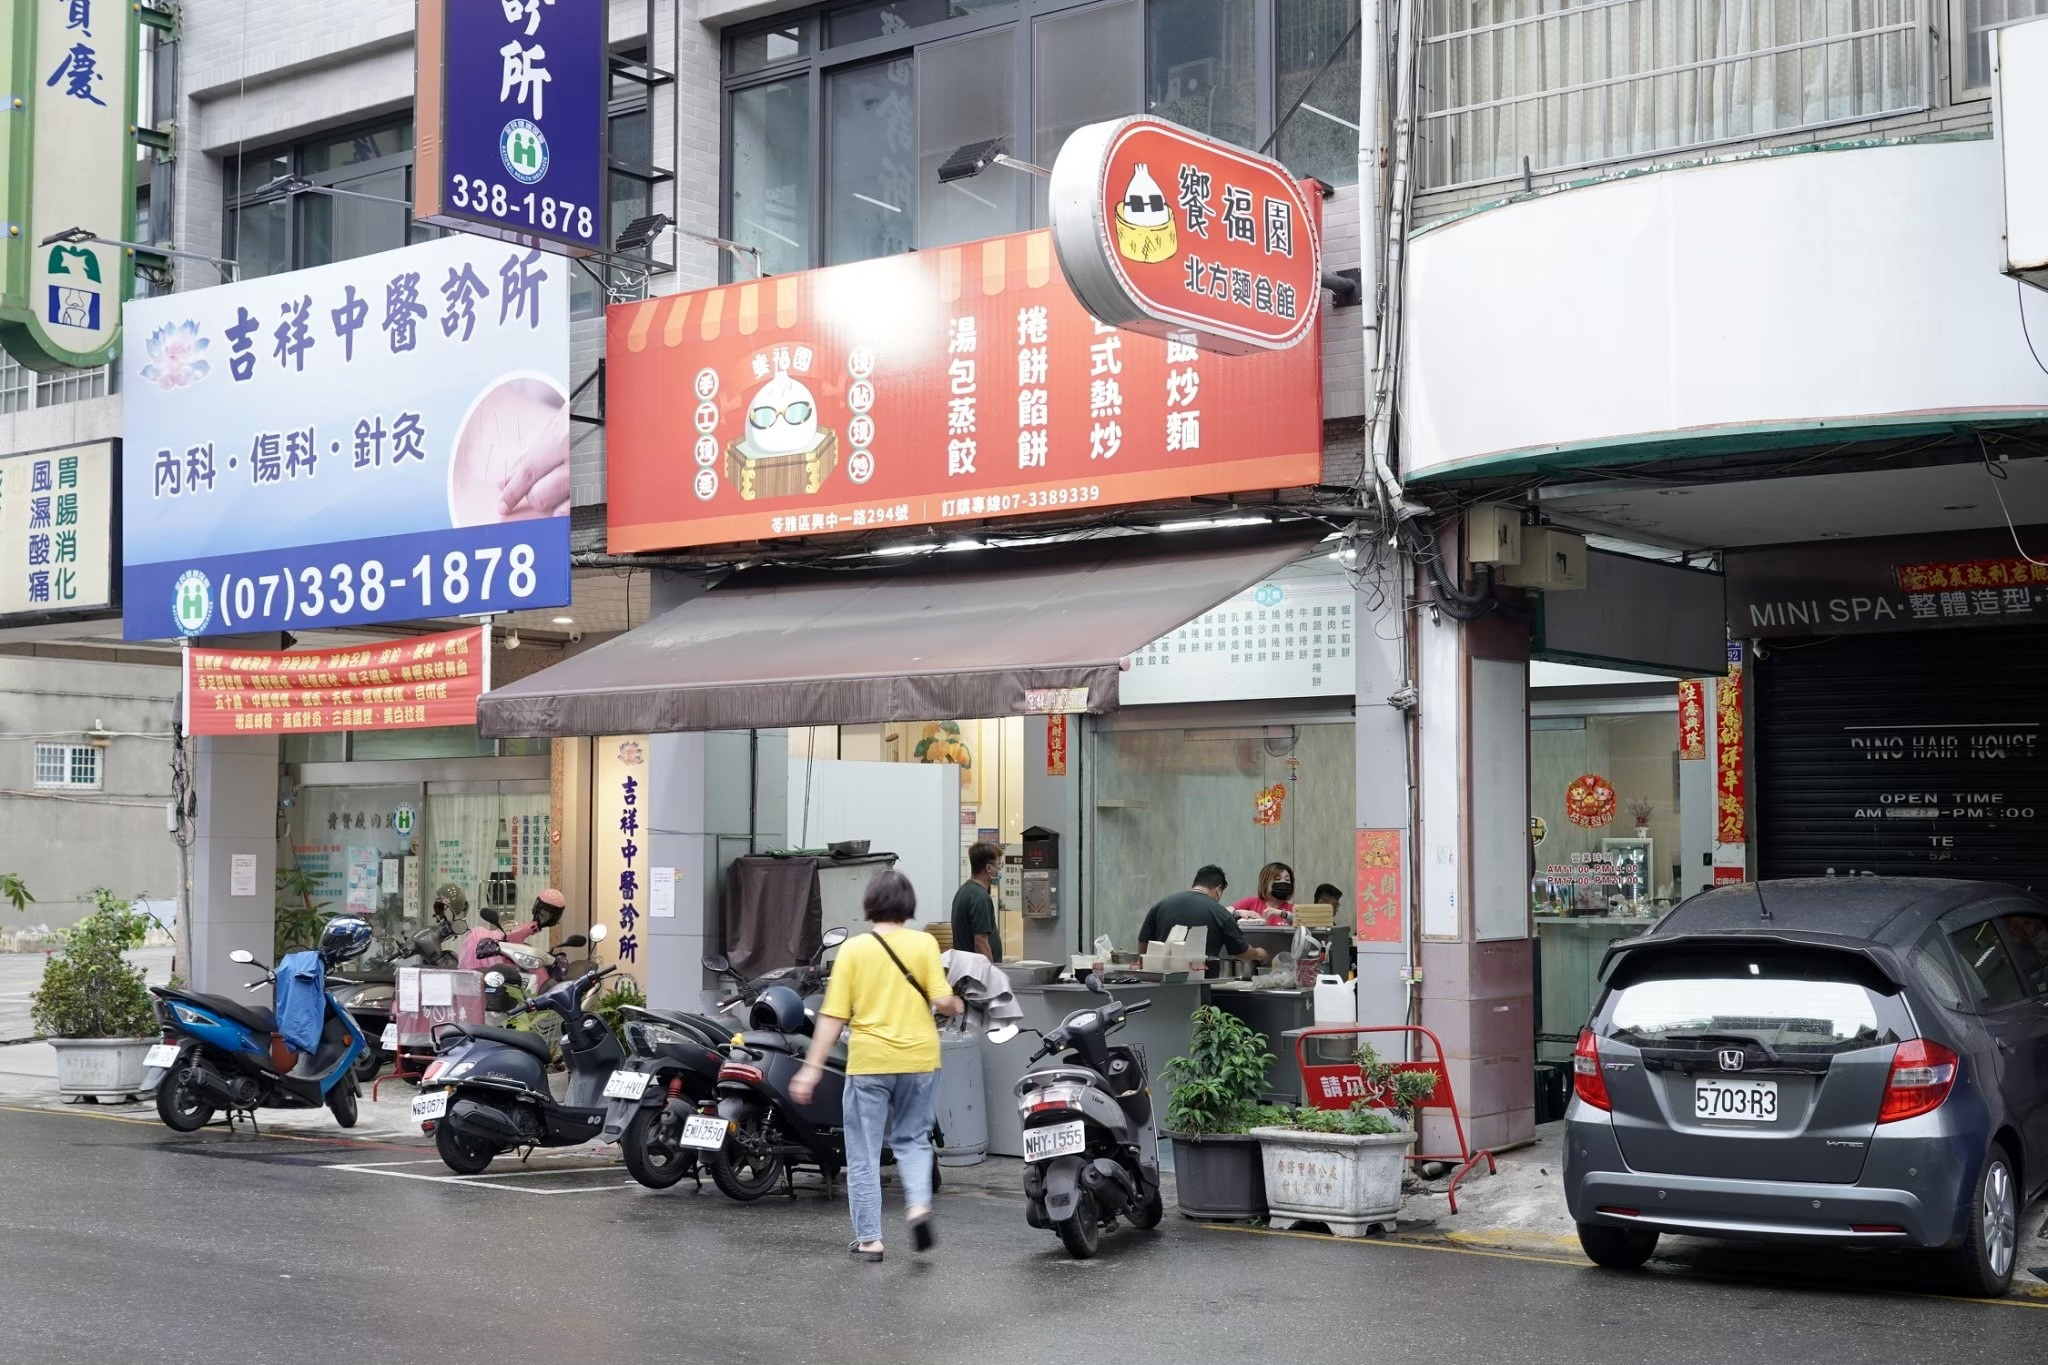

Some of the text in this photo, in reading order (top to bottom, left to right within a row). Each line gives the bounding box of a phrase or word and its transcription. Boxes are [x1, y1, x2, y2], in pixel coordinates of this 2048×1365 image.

[452, 174, 593, 238] 338-1878
[1178, 165, 1293, 256] 饗福園
[224, 247, 548, 383] 吉祥中醫診所
[1184, 255, 1296, 318] 北方麵食館
[948, 316, 977, 476] 湯包蒸餃
[1017, 305, 1048, 469] 捲餅餡餅
[29, 459, 52, 603] 風濕酸痛
[54, 456, 78, 601] 胃腸消化
[219, 543, 537, 626] (07)338-1878
[1750, 601, 1820, 627] MINI
[1684, 684, 1702, 748] 生意興隆
[1880, 793, 2004, 804] OPEN TIME
[1929, 836, 1954, 847] TE
[618, 775, 640, 964] 吉祥中醫診所
